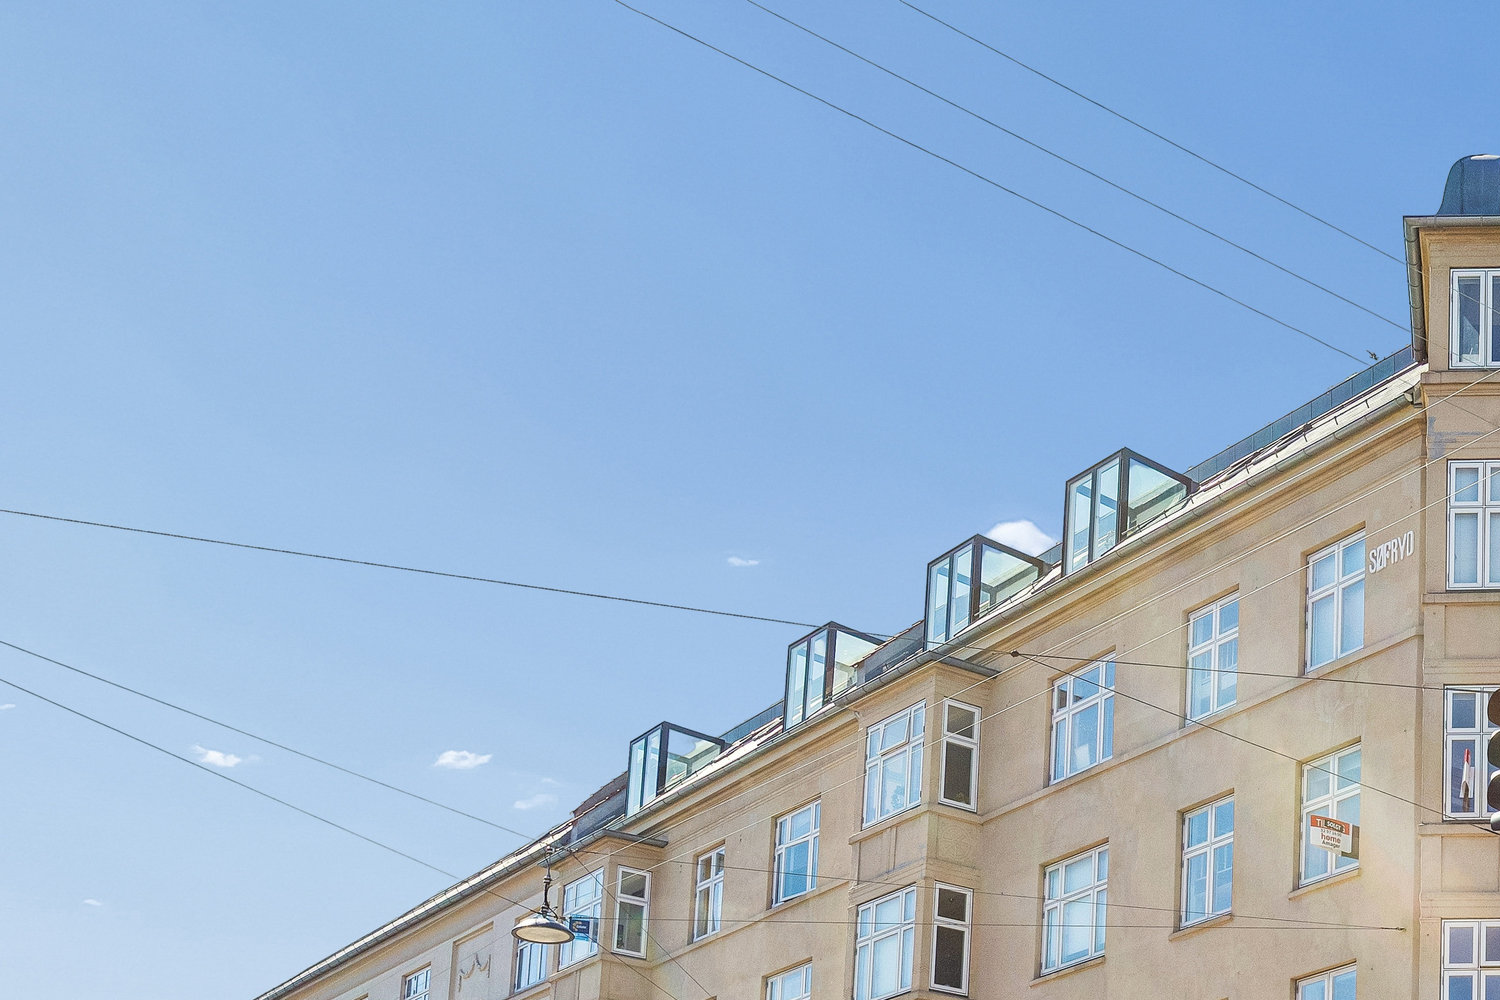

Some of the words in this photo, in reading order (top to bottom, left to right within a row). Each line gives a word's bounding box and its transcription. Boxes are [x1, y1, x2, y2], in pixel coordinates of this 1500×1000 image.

[1369, 530, 1414, 574] SØFRYD
[1321, 832, 1341, 844] home
[1322, 840, 1341, 849] Amager
